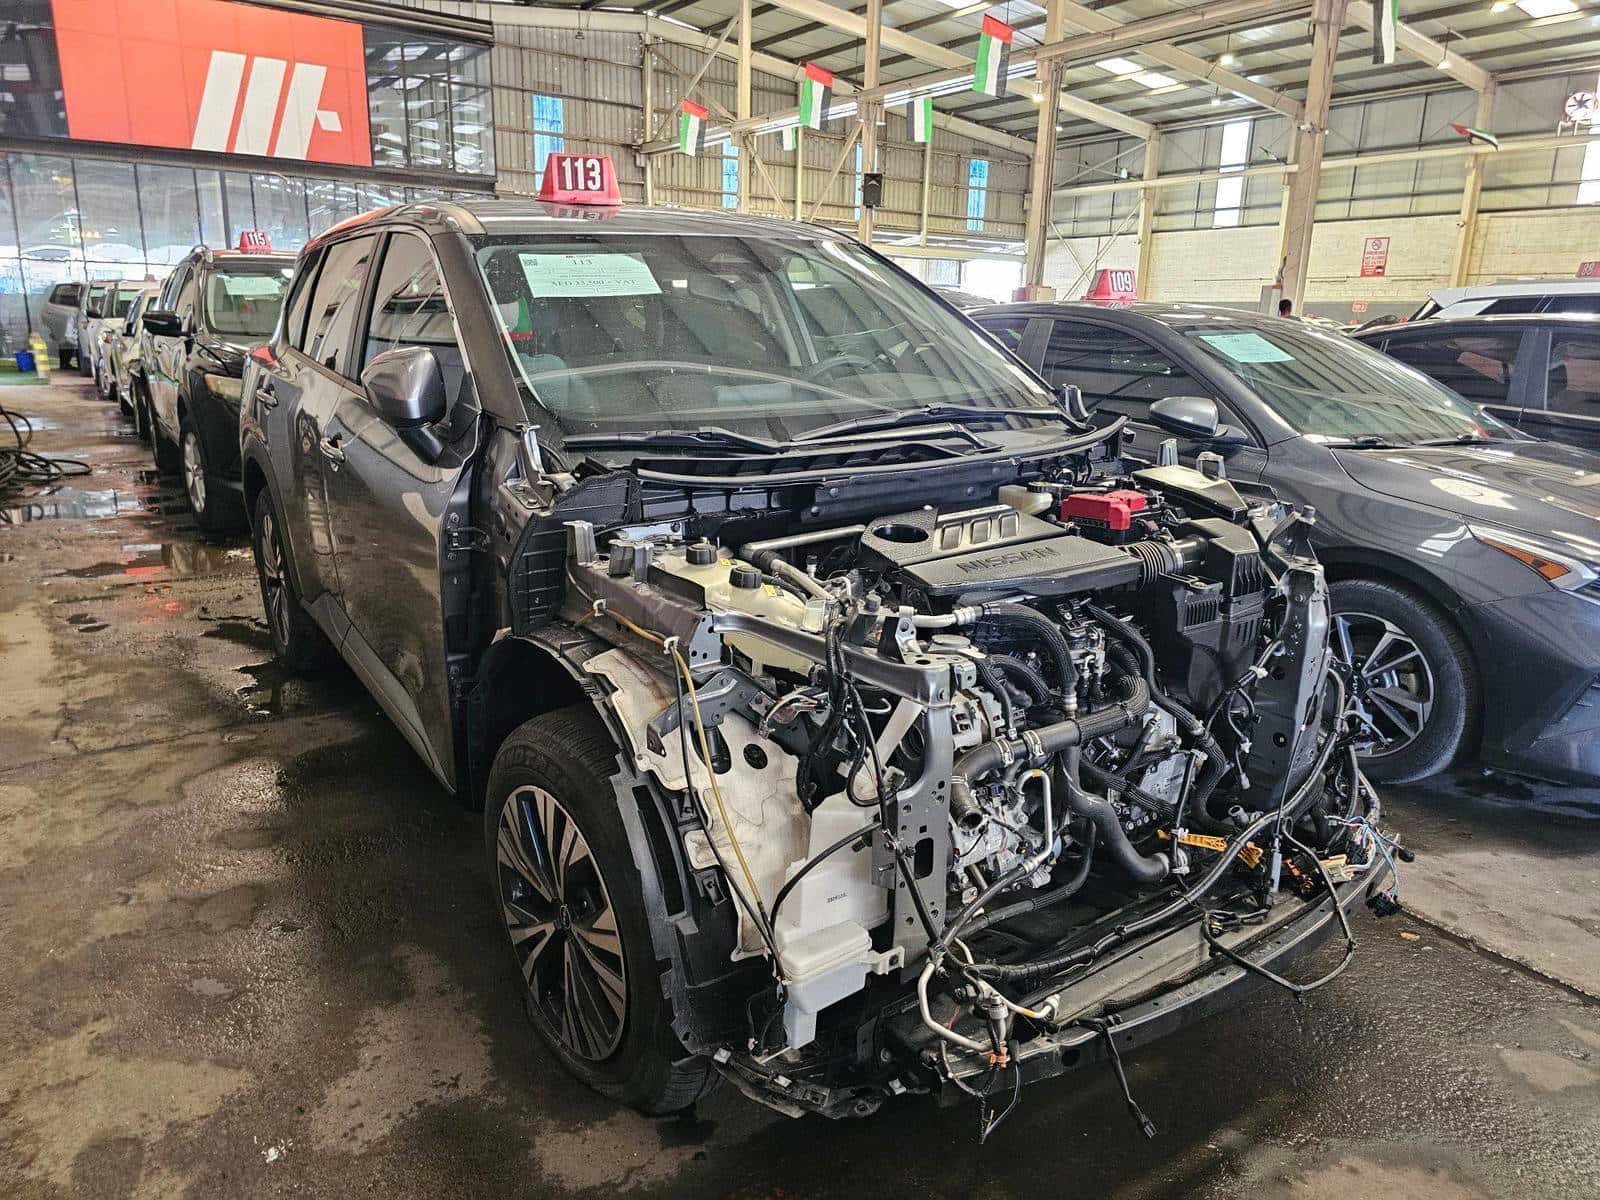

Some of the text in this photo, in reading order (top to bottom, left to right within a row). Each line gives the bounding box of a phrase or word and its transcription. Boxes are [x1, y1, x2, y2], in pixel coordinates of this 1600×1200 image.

[562, 157, 601, 191] 113
[248, 232, 266, 246] 115
[1111, 271, 1133, 292] 109
[956, 546, 1060, 574] NISSAN
